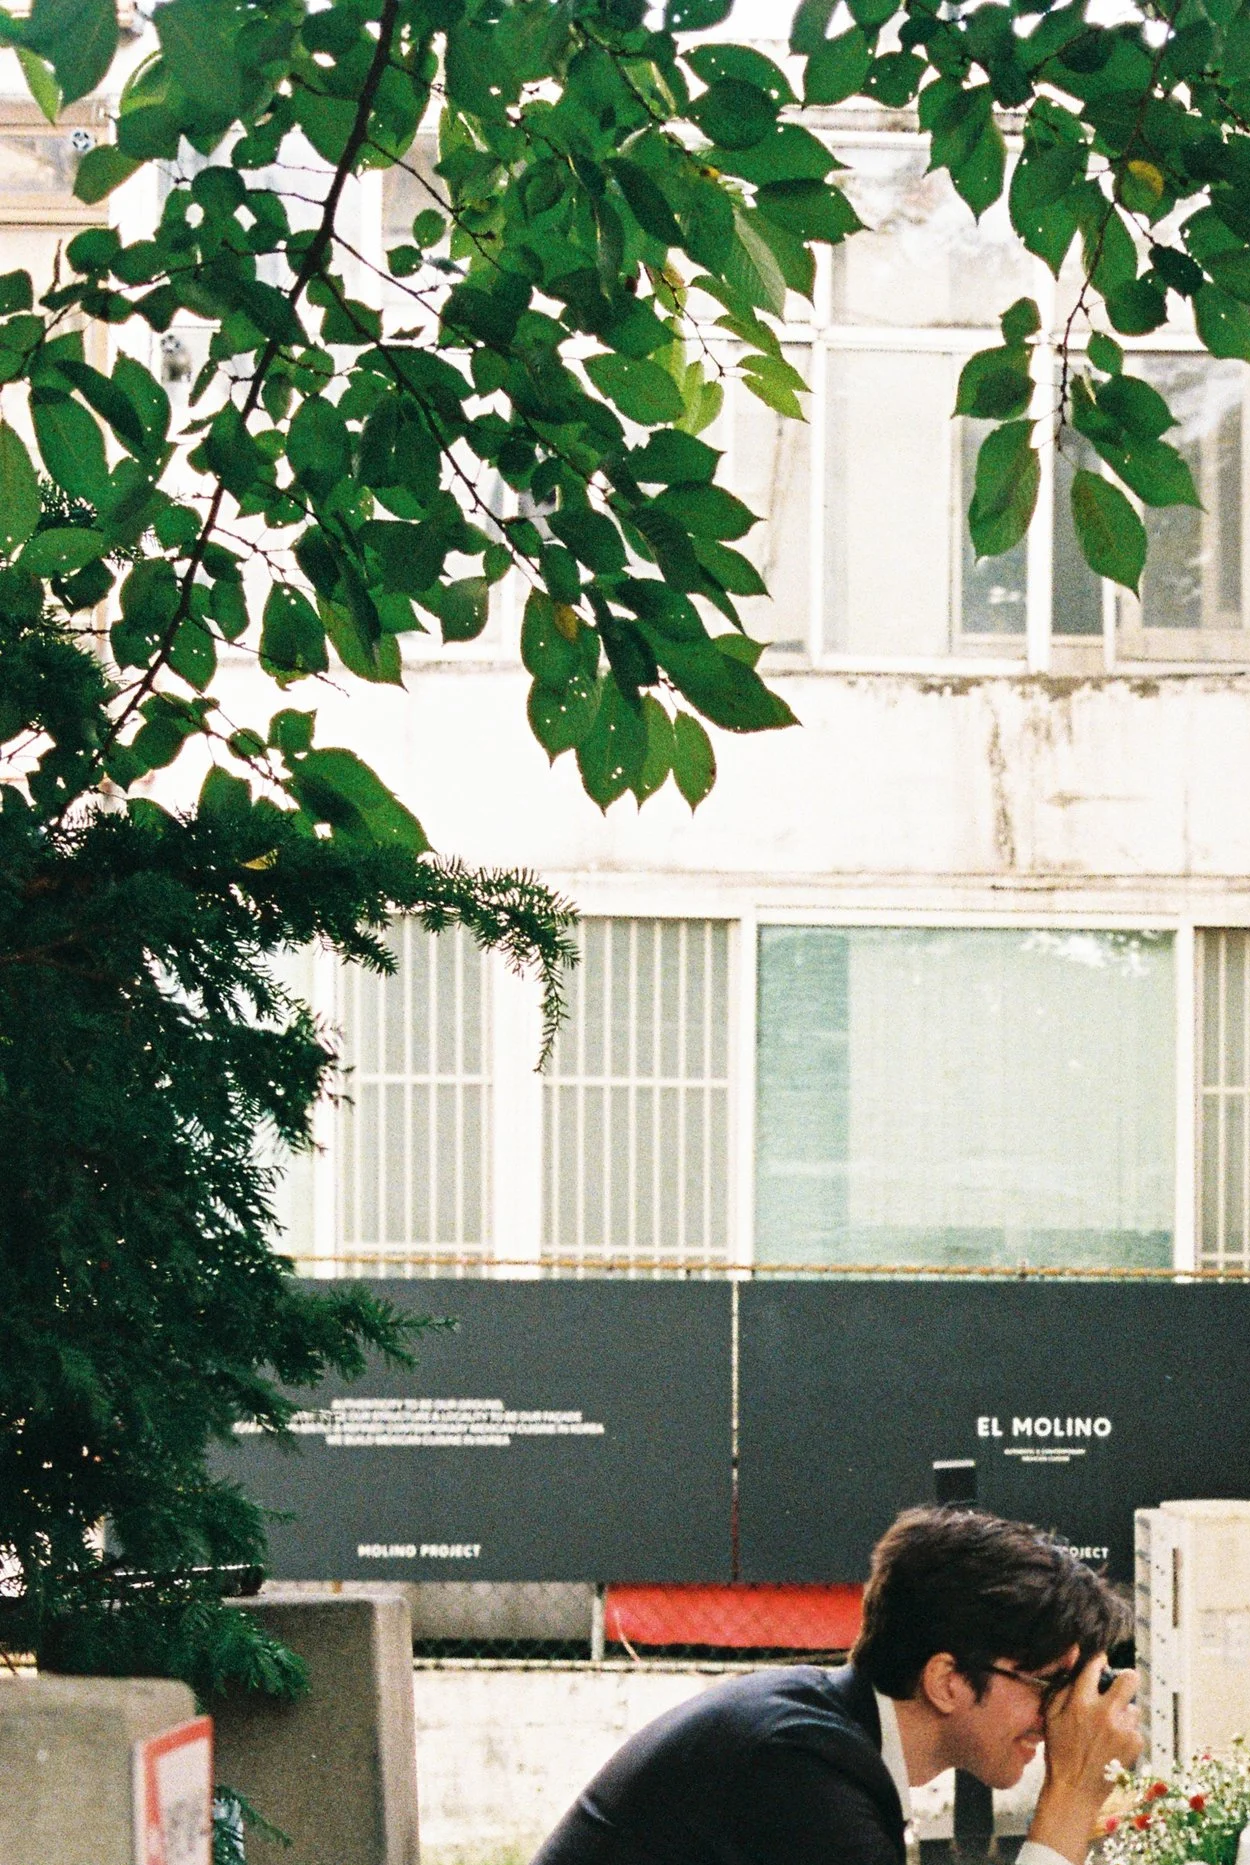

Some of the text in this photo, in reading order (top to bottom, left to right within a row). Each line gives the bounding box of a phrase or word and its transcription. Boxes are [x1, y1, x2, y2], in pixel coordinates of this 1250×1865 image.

[977, 1416, 1112, 1437] EL MOLINO
[357, 1543, 481, 1558] MOLINO PROJECT
